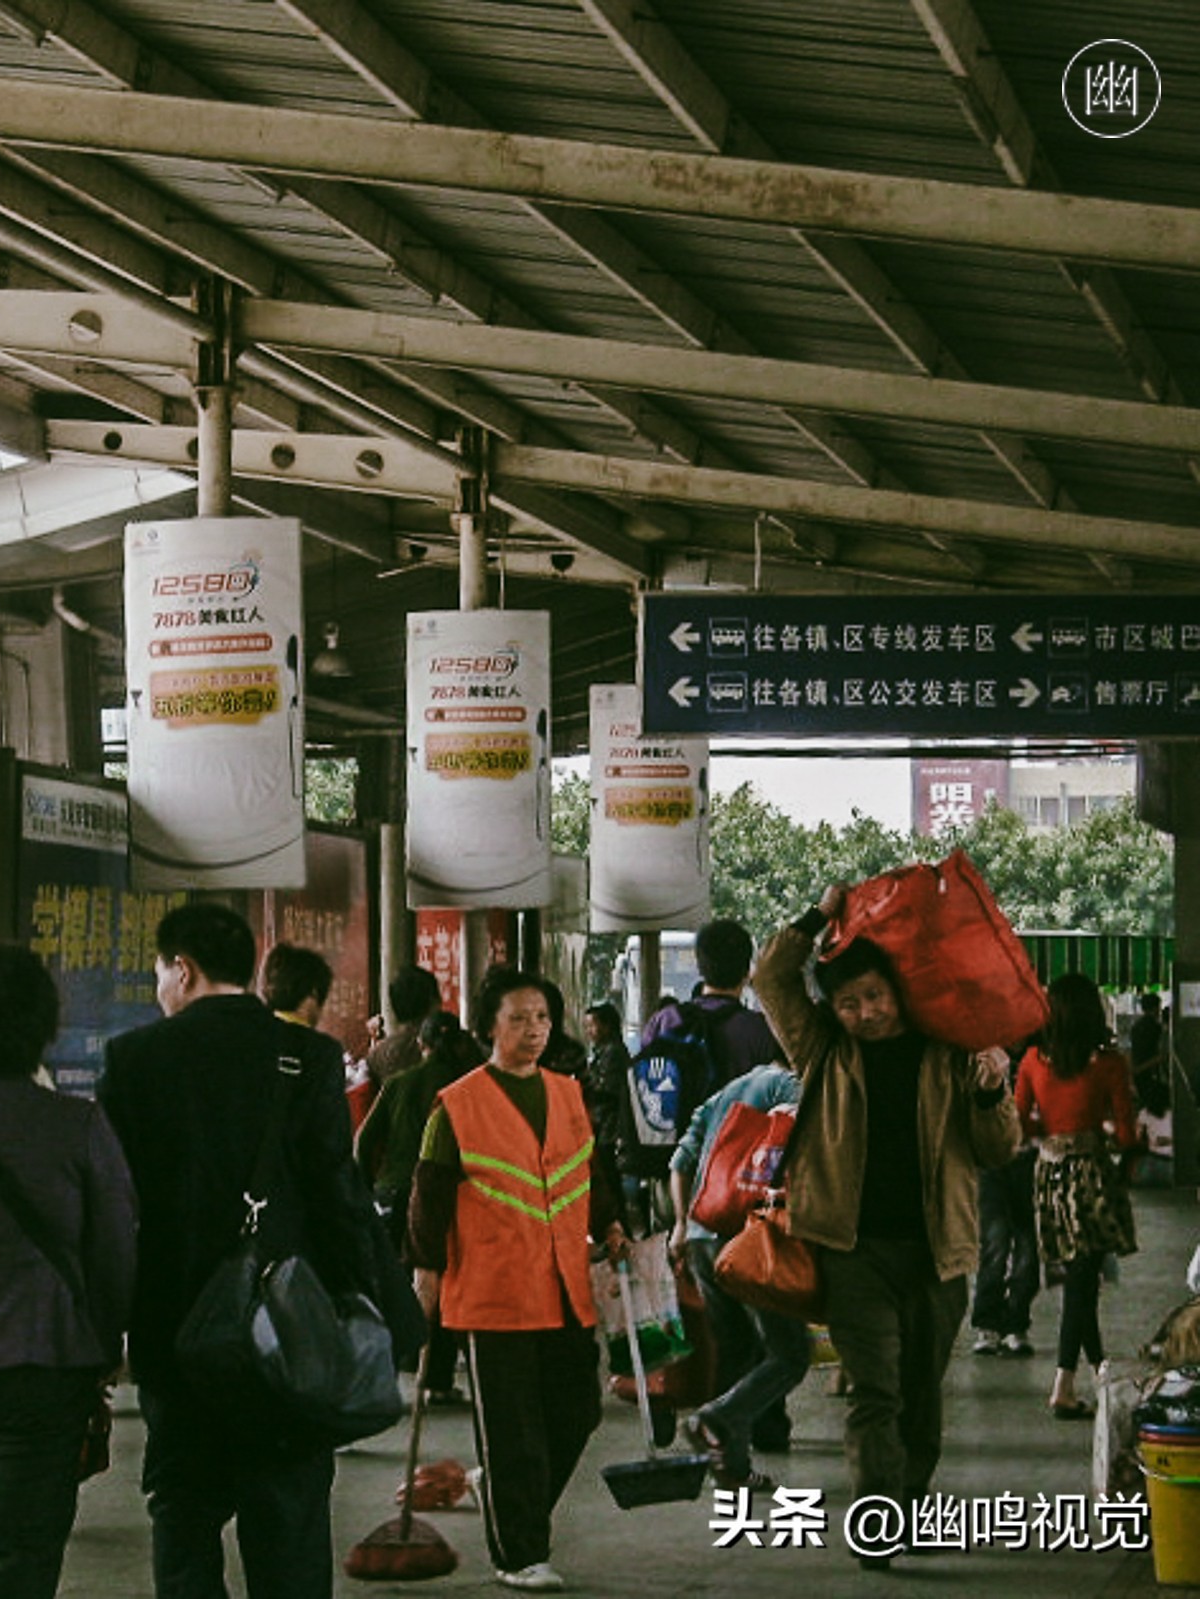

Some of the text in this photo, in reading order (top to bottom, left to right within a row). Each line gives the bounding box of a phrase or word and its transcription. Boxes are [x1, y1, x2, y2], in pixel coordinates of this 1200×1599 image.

[153, 571, 250, 597] 12580
[753, 624, 996, 651] 往各镇、区专线发车区
[1095, 624, 1200, 651] 市区城巴
[753, 678, 997, 706] 往各镇、区公交发车区
[1095, 680, 1169, 705] 售票厅
